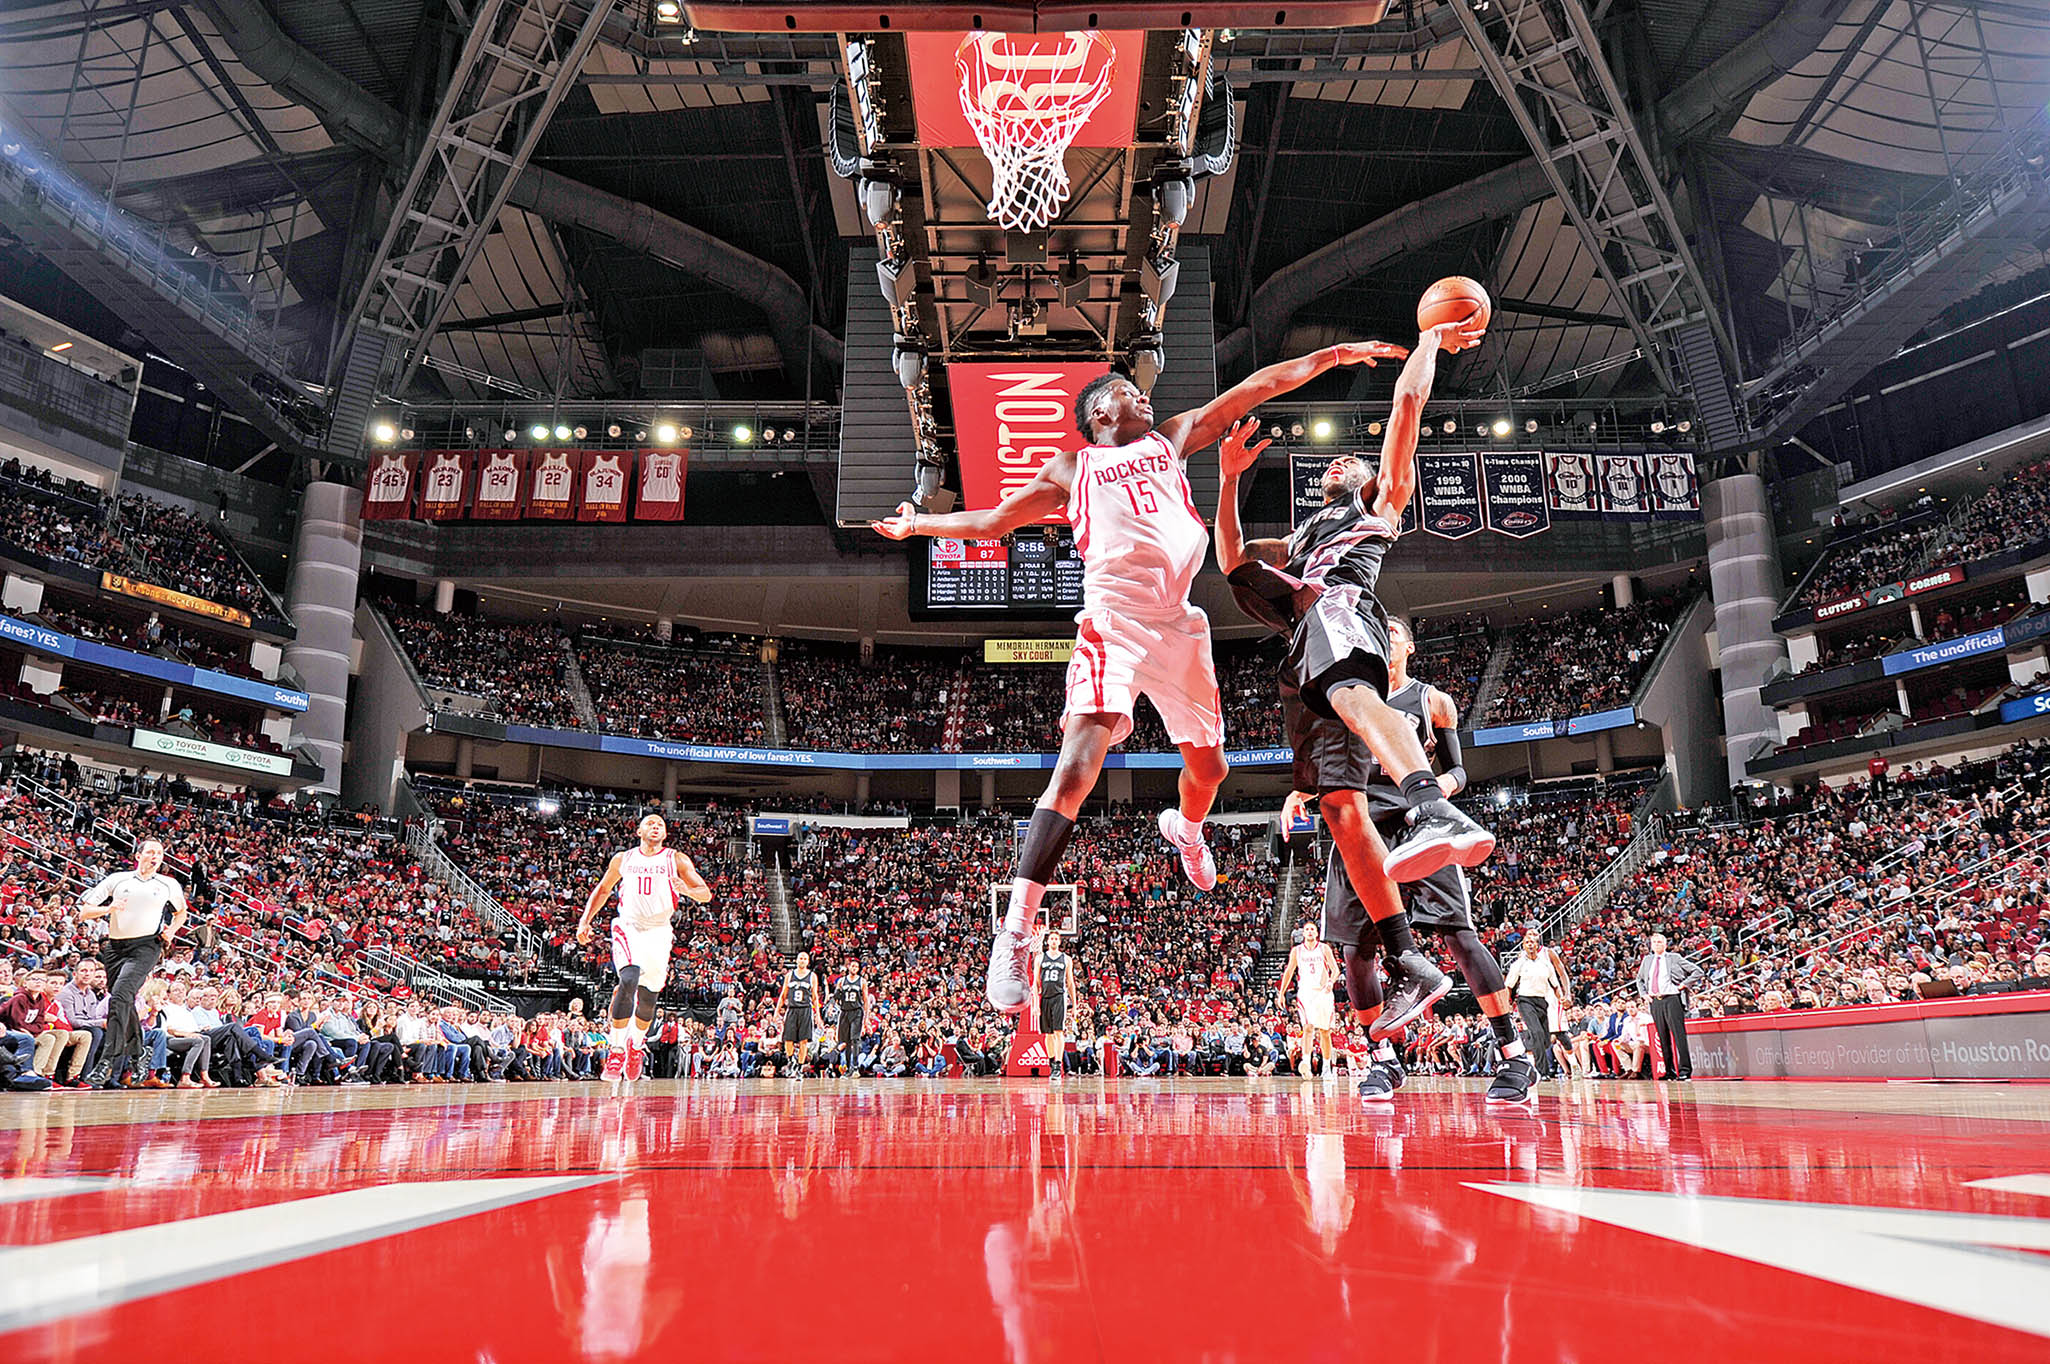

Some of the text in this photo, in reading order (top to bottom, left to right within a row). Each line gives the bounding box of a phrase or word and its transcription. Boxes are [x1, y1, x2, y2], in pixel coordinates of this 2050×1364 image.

[1094, 454, 1169, 486] ROCKETS
[382, 474, 399, 486] 45
[438, 474, 453, 486] 23
[491, 473, 508, 485] 24
[545, 473, 561, 485] 22
[596, 475, 613, 488] 34
[1308, 477, 1323, 486] 19
[1436, 476, 1462, 485] 1999
[1501, 475, 1527, 483] 2000
[1566, 479, 1577, 489] 10
[1304, 488, 1323, 496] WN
[1433, 486, 1466, 495] WNBA
[1499, 484, 1532, 493] WNBA
[1121, 480, 1159, 516] 15
[1425, 497, 1477, 507] Champions
[1490, 495, 1543, 505] Champions
[980, 550, 995, 559] 87
[1817, 572, 1951, 617] CLUTCH'S CORNER
[0, 619, 61, 649] fares? YES.
[996, 641, 1070, 650] MEMORIAL HERMANN
[1912, 652, 1938, 664] The
[1939, 632, 2004, 658] unofficial
[1013, 651, 1053, 660] SKY COURT
[175, 740, 207, 752] TOYOTA
[242, 753, 272, 765] TOYOTA
[647, 743, 815, 764] The unofficial MVP of low fares? YES.
[1252, 752, 1273, 762] MVP
[1275, 751, 1284, 760] of
[1286, 750, 1294, 760] lo
[973, 757, 1016, 765] Southwest
[638, 876, 652, 895] 10
[1309, 963, 1315, 974] 3
[1690, 1045, 1726, 1069] eliant
[1755, 1047, 1793, 1066] Official
[1795, 1046, 1835, 1070] Energy
[1838, 1044, 1892, 1065] Provider
[1896, 1042, 1912, 1063] of
[1913, 1043, 1941, 1063] the
[1942, 1041, 2023, 1063] Houston
